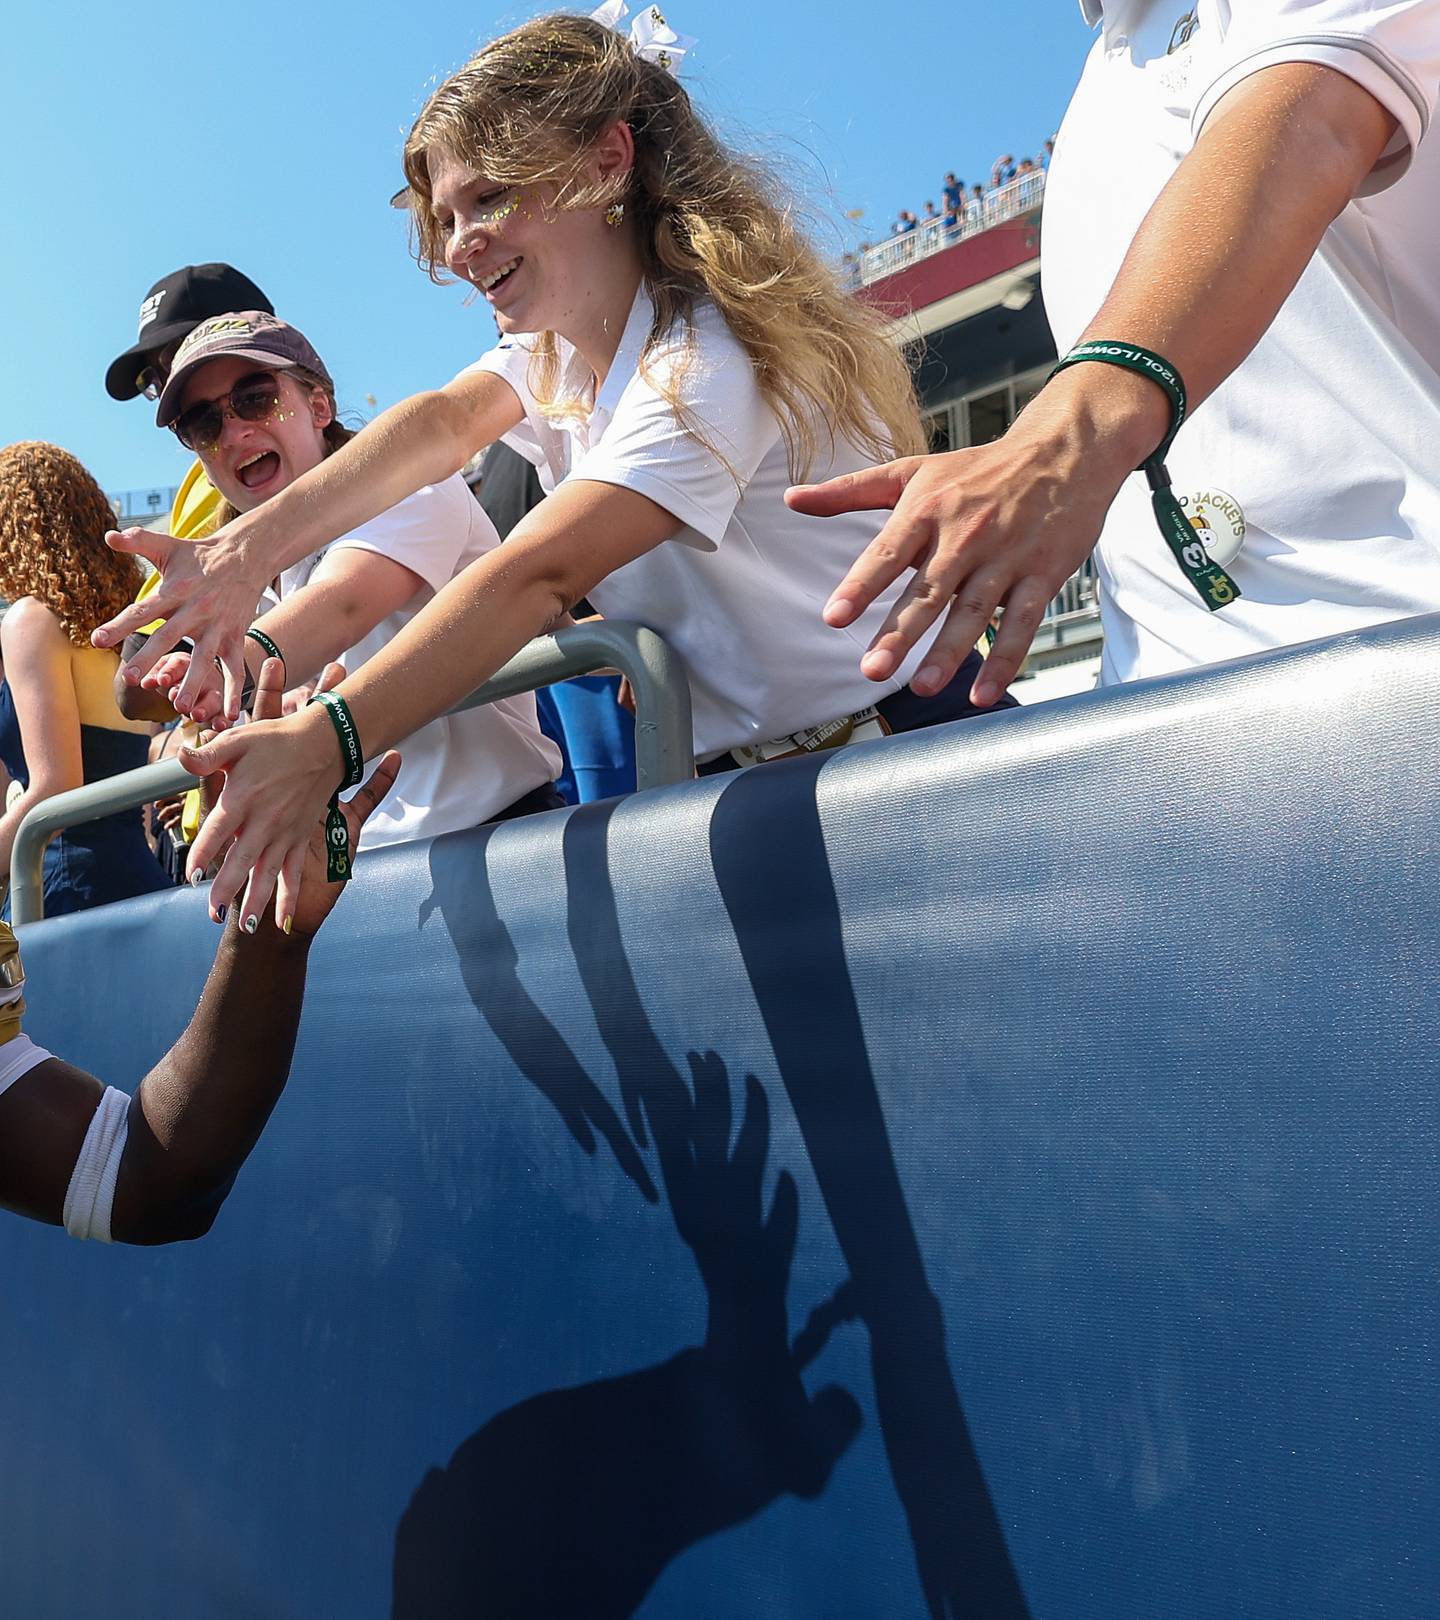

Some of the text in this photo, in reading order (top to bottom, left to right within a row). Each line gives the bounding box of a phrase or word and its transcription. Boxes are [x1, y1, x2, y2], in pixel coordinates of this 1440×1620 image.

[1192, 491, 1246, 536] JACKETS
[804, 737, 820, 751] THE
[817, 717, 849, 742] JACKETS
